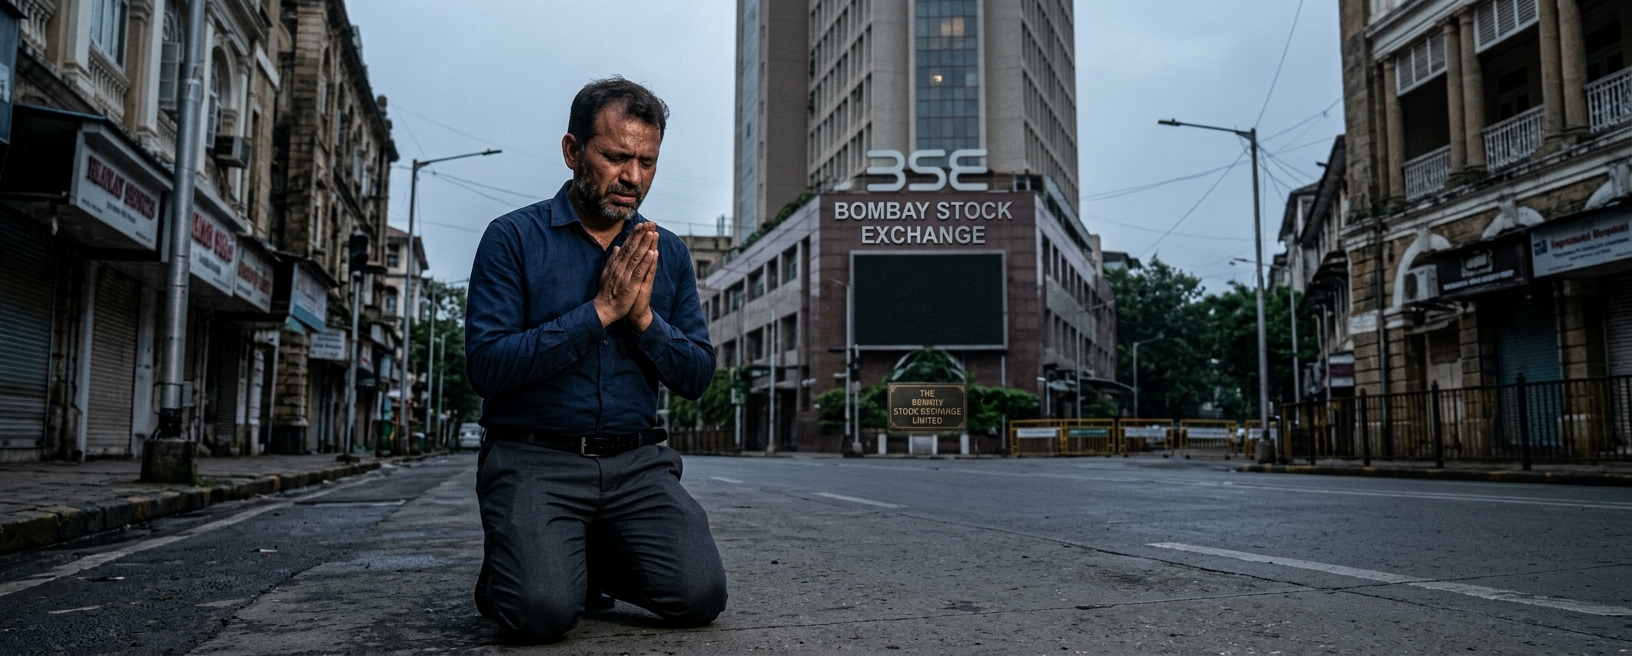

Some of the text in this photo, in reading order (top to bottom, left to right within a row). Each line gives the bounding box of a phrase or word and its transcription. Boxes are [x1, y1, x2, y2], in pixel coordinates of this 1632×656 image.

[866, 149, 988, 191] BSE
[834, 201, 1013, 220] BOMBAY STOCK
[861, 225, 986, 244] EXCHANGE
[920, 389, 935, 397] THE
